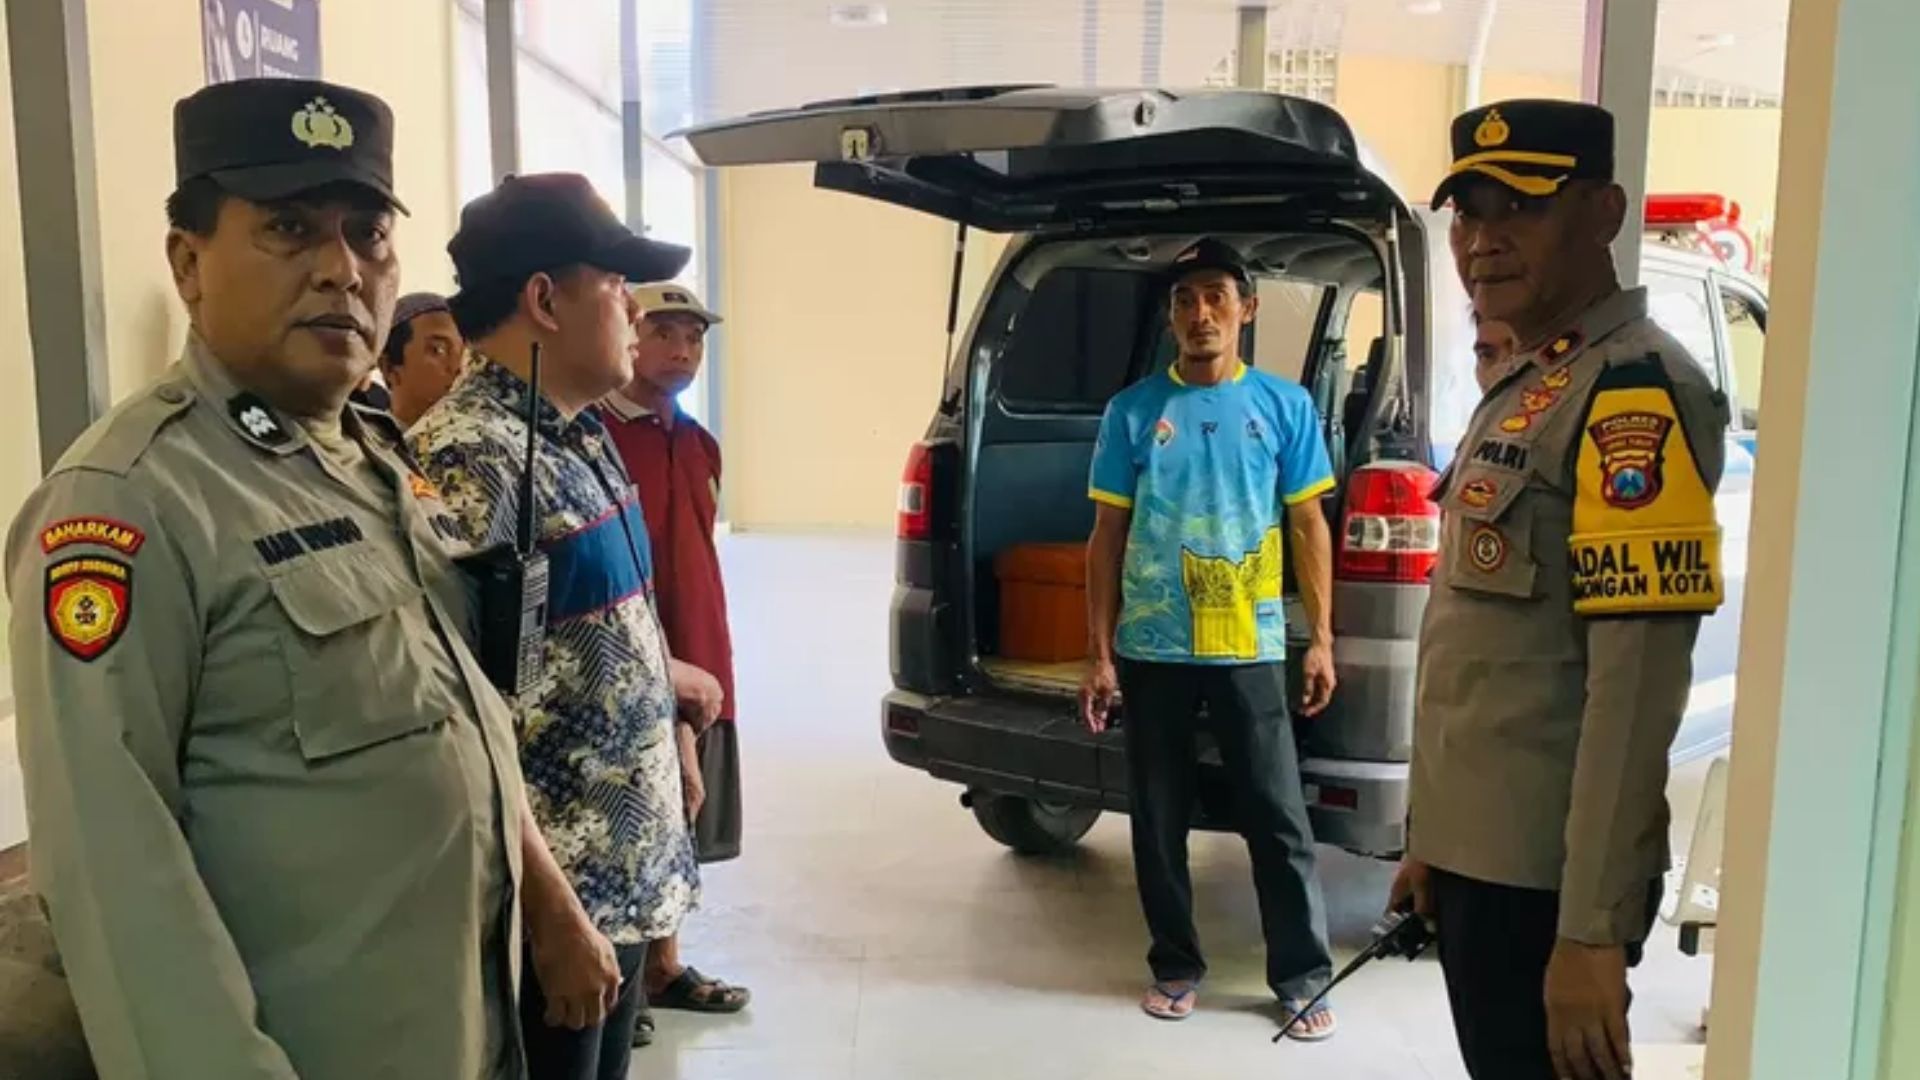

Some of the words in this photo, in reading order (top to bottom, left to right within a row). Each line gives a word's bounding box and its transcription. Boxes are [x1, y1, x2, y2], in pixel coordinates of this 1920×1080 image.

[1472, 440, 1527, 471] POLRI
[1652, 540, 1710, 572] WIL
[1659, 573, 1714, 595] KOTA
